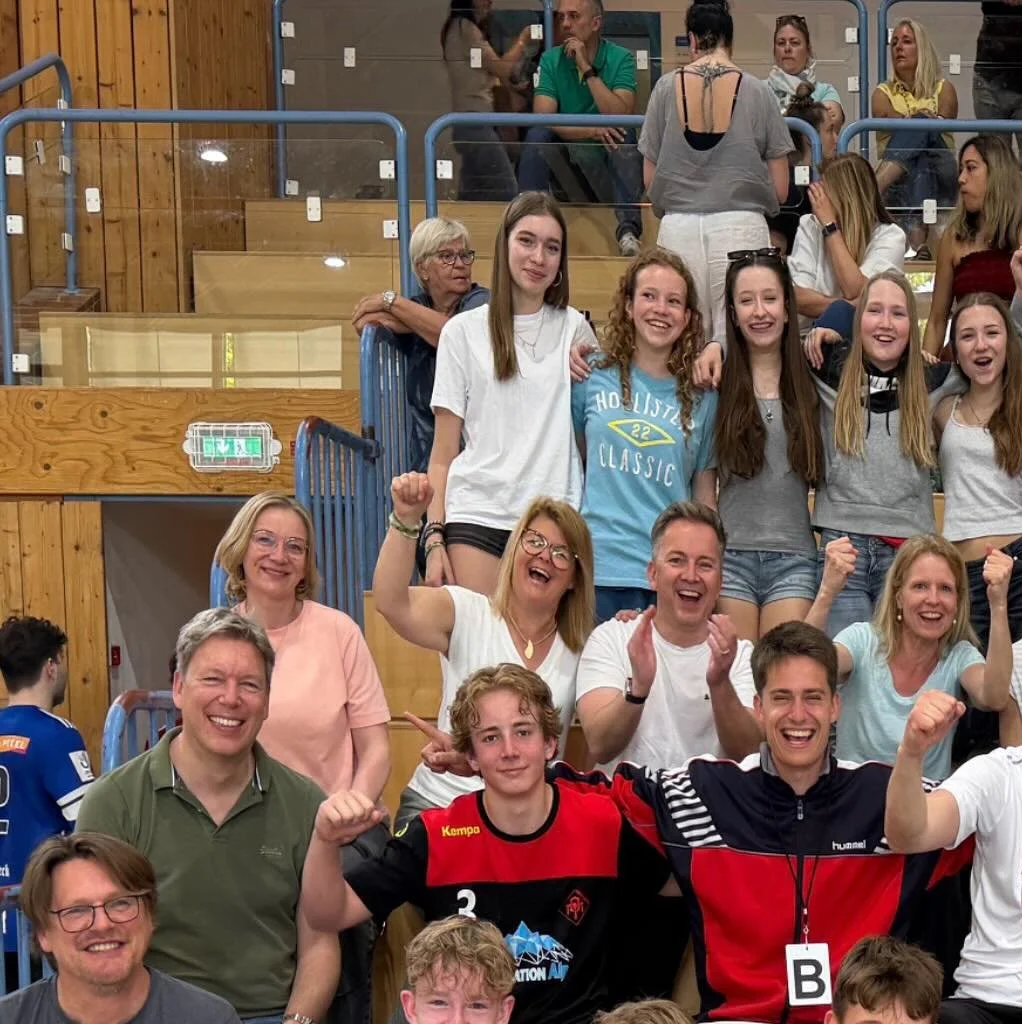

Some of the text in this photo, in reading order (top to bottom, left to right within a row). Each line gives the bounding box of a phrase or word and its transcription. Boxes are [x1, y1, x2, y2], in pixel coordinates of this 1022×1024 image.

[594, 390, 696, 430] HOLISTE
[630, 423, 651, 440] 22
[599, 442, 675, 487] CLASSIC
[441, 824, 481, 837] Kempa
[832, 839, 867, 851] hummel
[793, 958, 826, 1000] B
